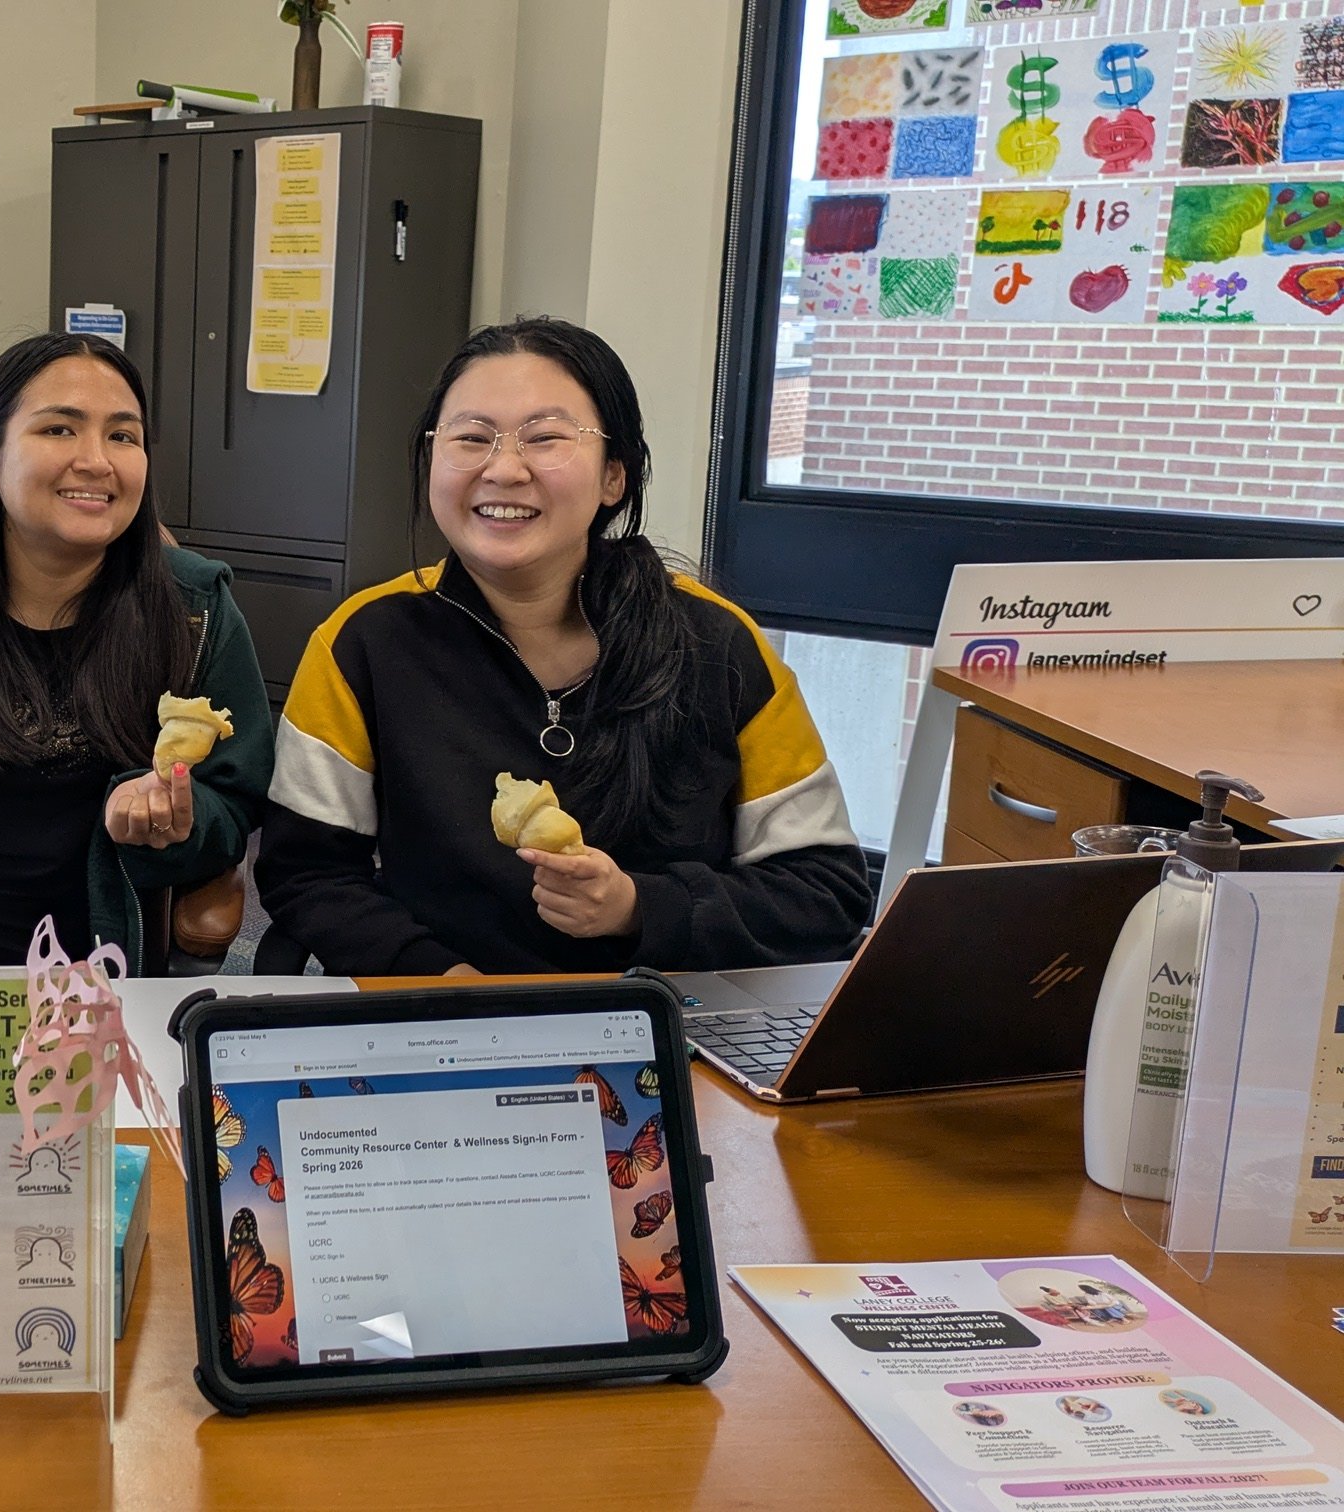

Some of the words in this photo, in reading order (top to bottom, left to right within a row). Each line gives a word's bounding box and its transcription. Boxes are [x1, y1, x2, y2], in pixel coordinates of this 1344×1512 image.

[979, 595, 1112, 630] Instagram
[1149, 992, 1189, 1009] Daily
[1147, 1006, 1190, 1021] Moist
[408, 1037, 459, 1047] forms.office.com
[300, 1127, 377, 1140] Undocumented
[301, 1145, 360, 1156] Community
[363, 1143, 411, 1153] Resource
[414, 1140, 448, 1150] Center
[454, 1138, 461, 1148] &
[464, 1136, 510, 1147] Wellness
[512, 1133, 548, 1146] Sign-In
[551, 1132, 577, 1142] Form
[302, 1162, 336, 1174] Spring
[339, 1160, 363, 1171] 2026
[17, 1184, 72, 1193] SOMETIMES
[309, 1239, 332, 1248] UCRC
[18, 1277, 74, 1285] OTHERTIMES
[854, 1297, 892, 1305] LANEY
[896, 1295, 954, 1304] COLLEGE
[861, 1304, 917, 1312] WELLNESS
[919, 1303, 959, 1311] CENTER
[842, 1316, 866, 1324] Now
[869, 1315, 919, 1325] accepting
[919, 1314, 980, 1324] applications
[982, 1313, 999, 1321] for
[855, 1324, 907, 1332] STUDENT
[911, 1323, 957, 1331] MENTAL
[958, 1321, 1006, 1330] HEALTH
[901, 1331, 976, 1340] NAVIGATORS
[888, 1341, 909, 1349] Fall
[911, 1340, 931, 1348] and
[932, 1340, 970, 1350] Spring
[18, 1360, 72, 1370] SOMETIMES
[970, 1378, 1074, 1393] NAVIGATORS
[1075, 1374, 1156, 1387] PROVIDE:
[1064, 1482, 1094, 1491] JOIN
[1097, 1480, 1127, 1489] OUR
[1127, 1478, 1166, 1488] TEAM
[1166, 1477, 1194, 1486] FOR
[1195, 1475, 1231, 1485] FALL
[1015, 1500, 1069, 1512] Applicants
[1070, 1501, 1097, 1509] must
[1098, 1499, 1121, 1507] have
[1121, 1496, 1176, 1507] experience
[1176, 1495, 1186, 1503] in
[1187, 1494, 1222, 1503] health
[1223, 1493, 1242, 1501] and
[1242, 1491, 1280, 1501] human
